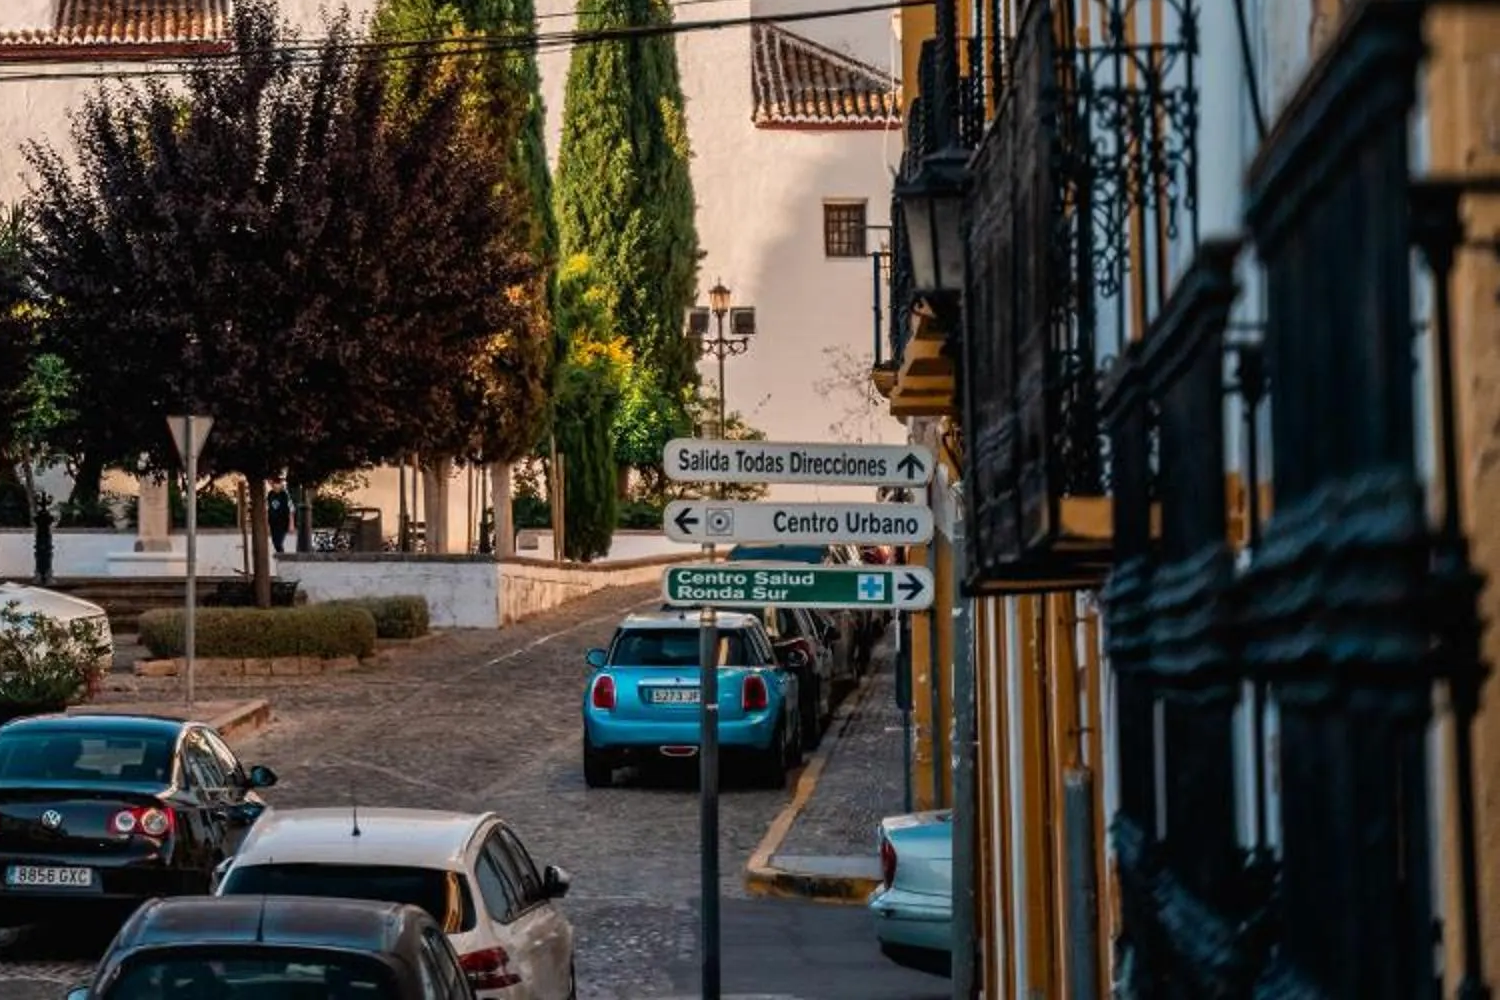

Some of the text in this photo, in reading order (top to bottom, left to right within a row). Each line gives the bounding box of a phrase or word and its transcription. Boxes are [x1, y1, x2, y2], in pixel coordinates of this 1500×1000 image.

[678, 448, 887, 476] Salida Todas Direcciones
[773, 510, 919, 535] Centro Urbano
[677, 571, 815, 586] Centro Salud
[677, 586, 789, 601] Ronda Sur
